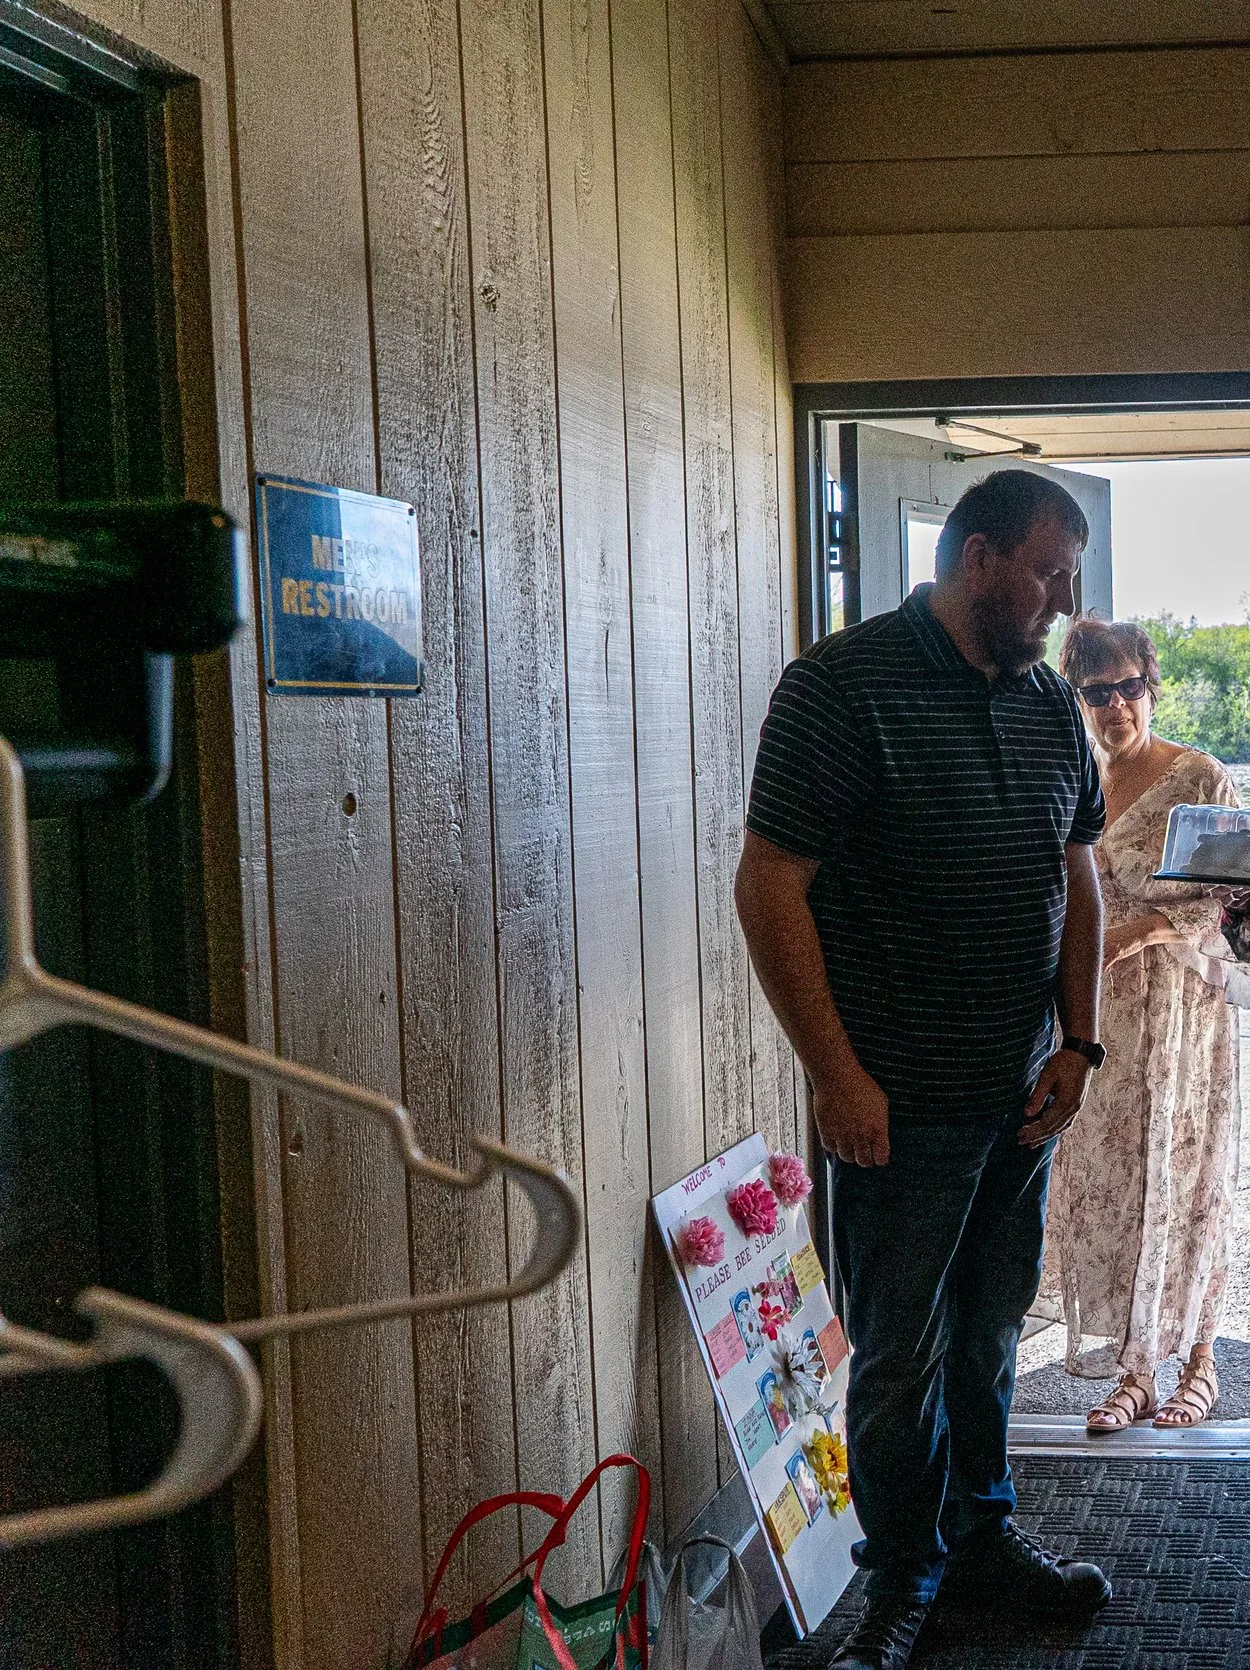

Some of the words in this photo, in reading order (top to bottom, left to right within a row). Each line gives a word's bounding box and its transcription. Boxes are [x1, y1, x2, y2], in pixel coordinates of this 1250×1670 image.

[311, 534, 380, 578] MEN'S
[281, 577, 408, 624] RESTROOM
[681, 1165, 713, 1196] WELCOME
[717, 1156, 726, 1170] TO
[694, 1263, 732, 1304] PLEASE
[734, 1246, 752, 1272] BEE
